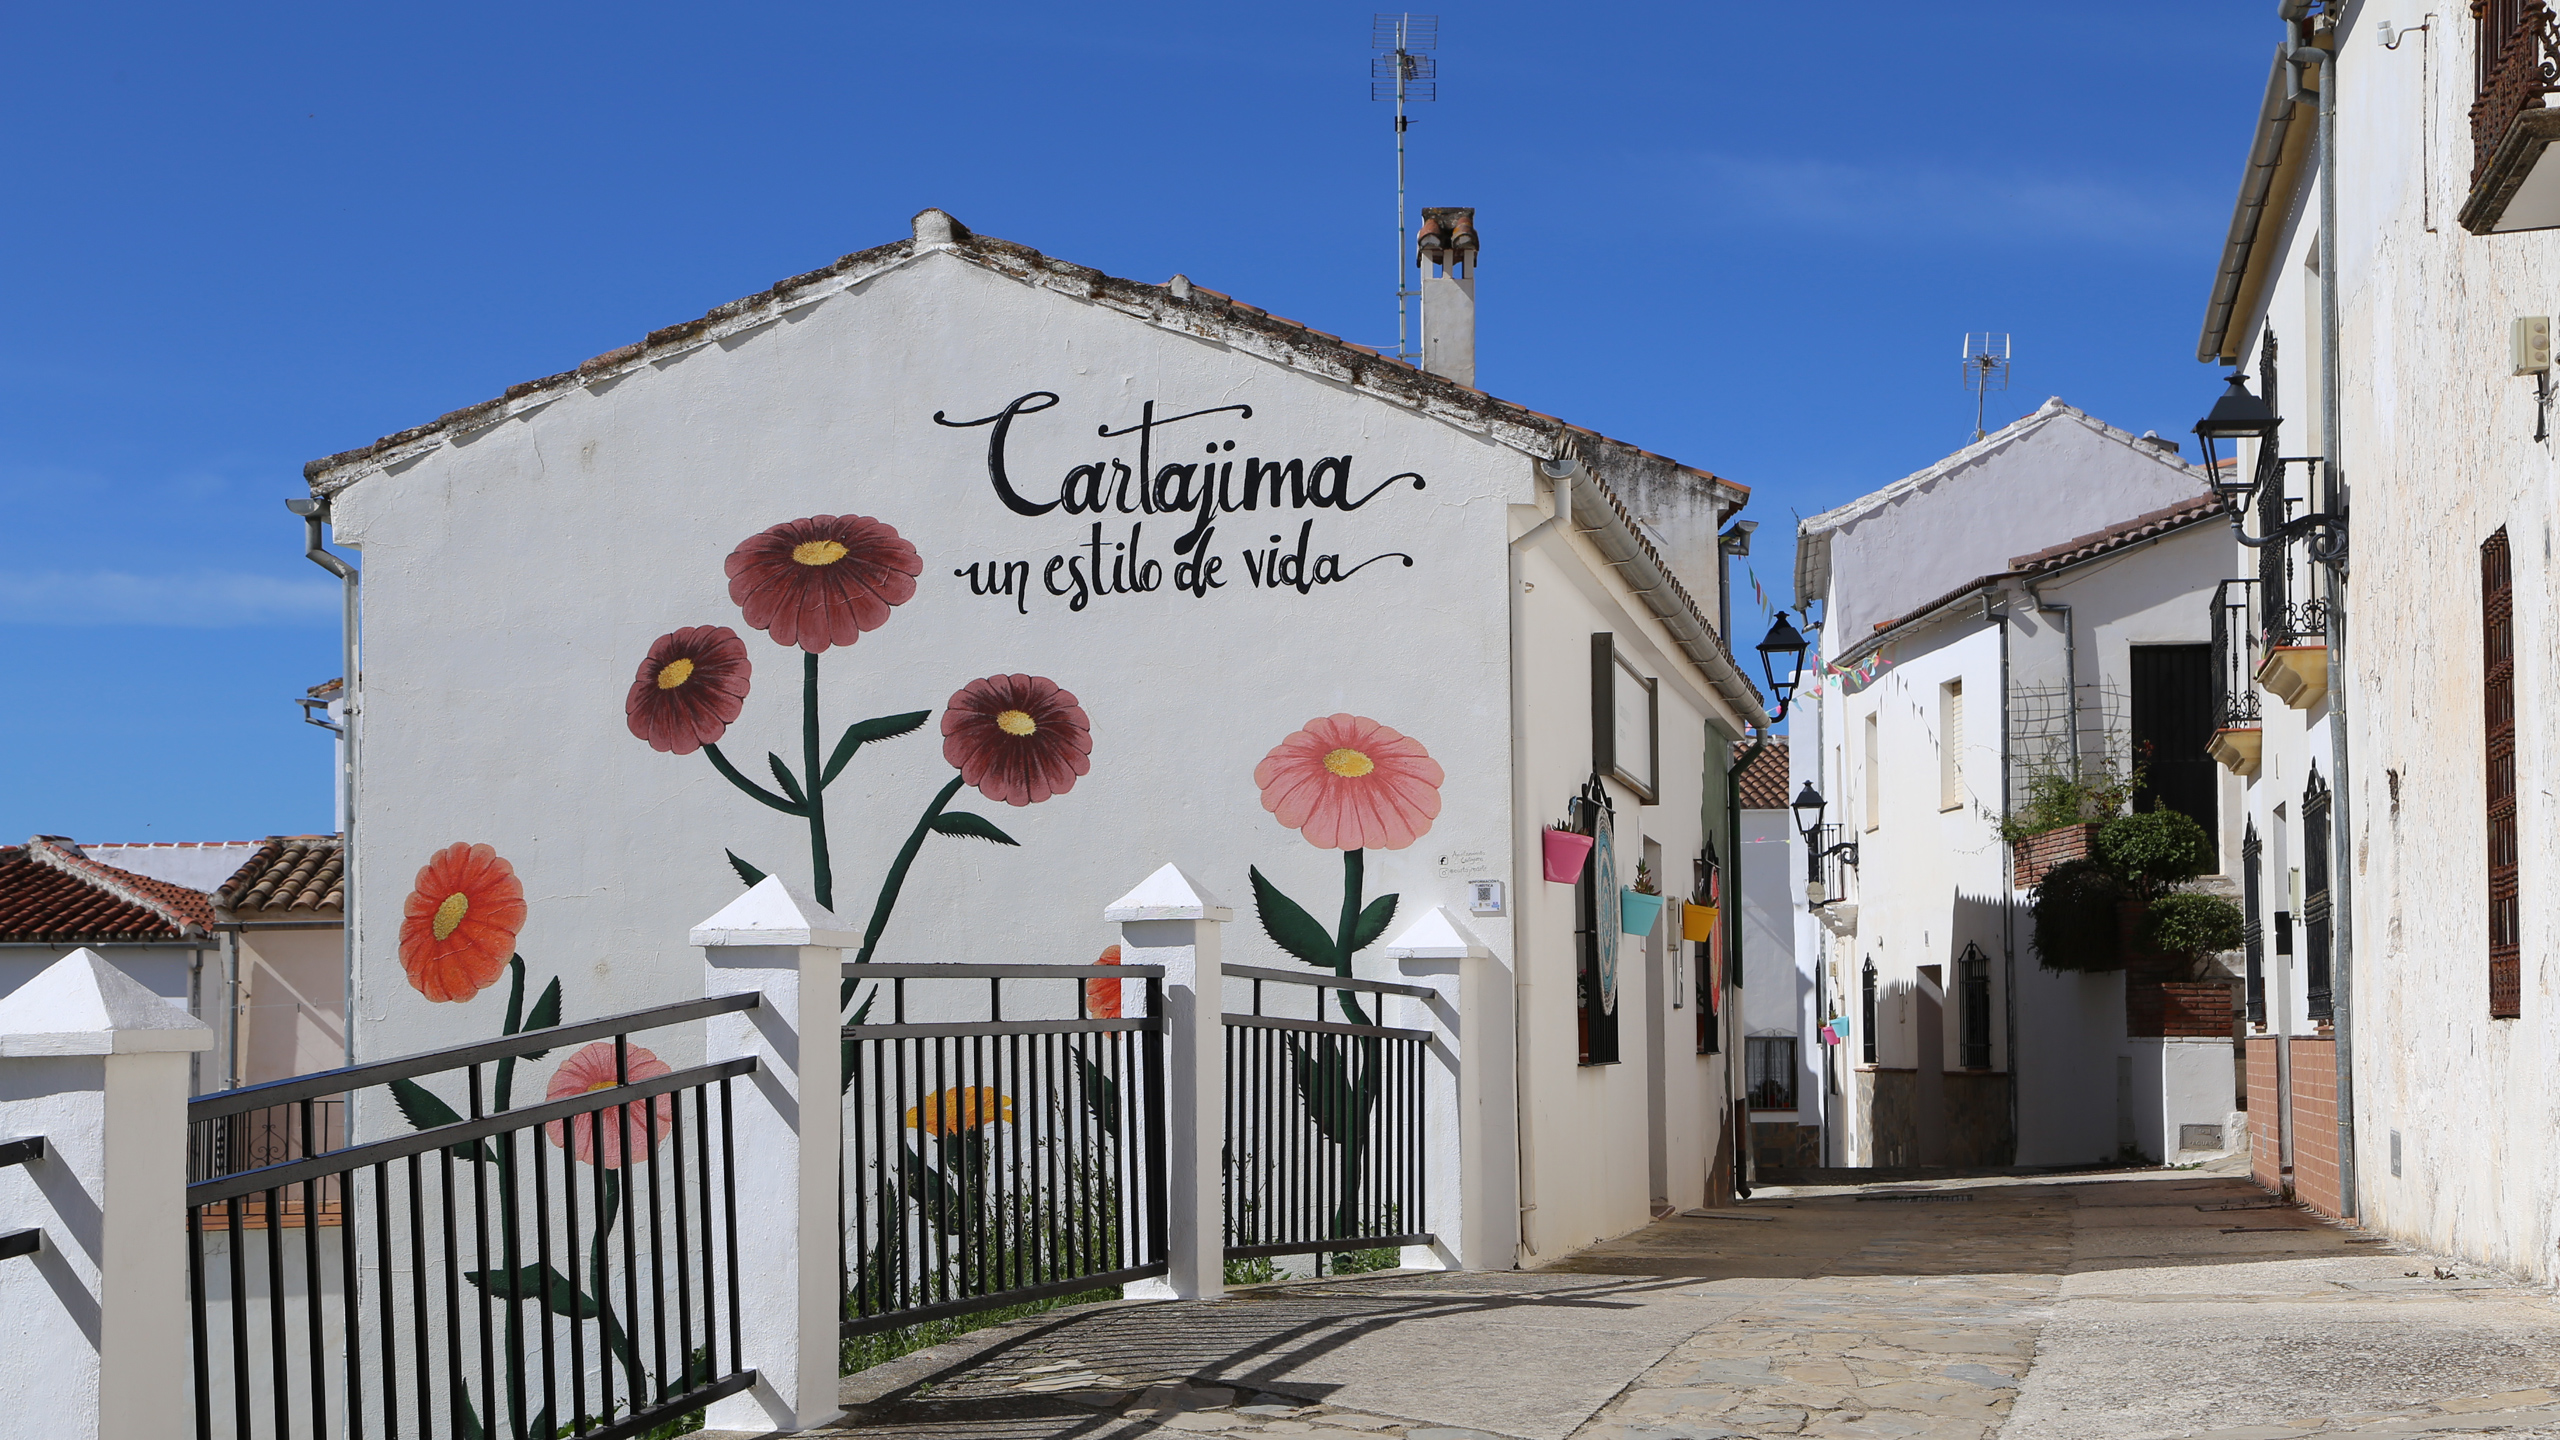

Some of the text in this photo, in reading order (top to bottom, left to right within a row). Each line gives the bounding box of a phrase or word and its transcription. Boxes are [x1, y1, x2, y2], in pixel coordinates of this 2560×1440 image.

[933, 391, 1426, 556] Cartajima
[954, 518, 1414, 615] un estilo de vida
